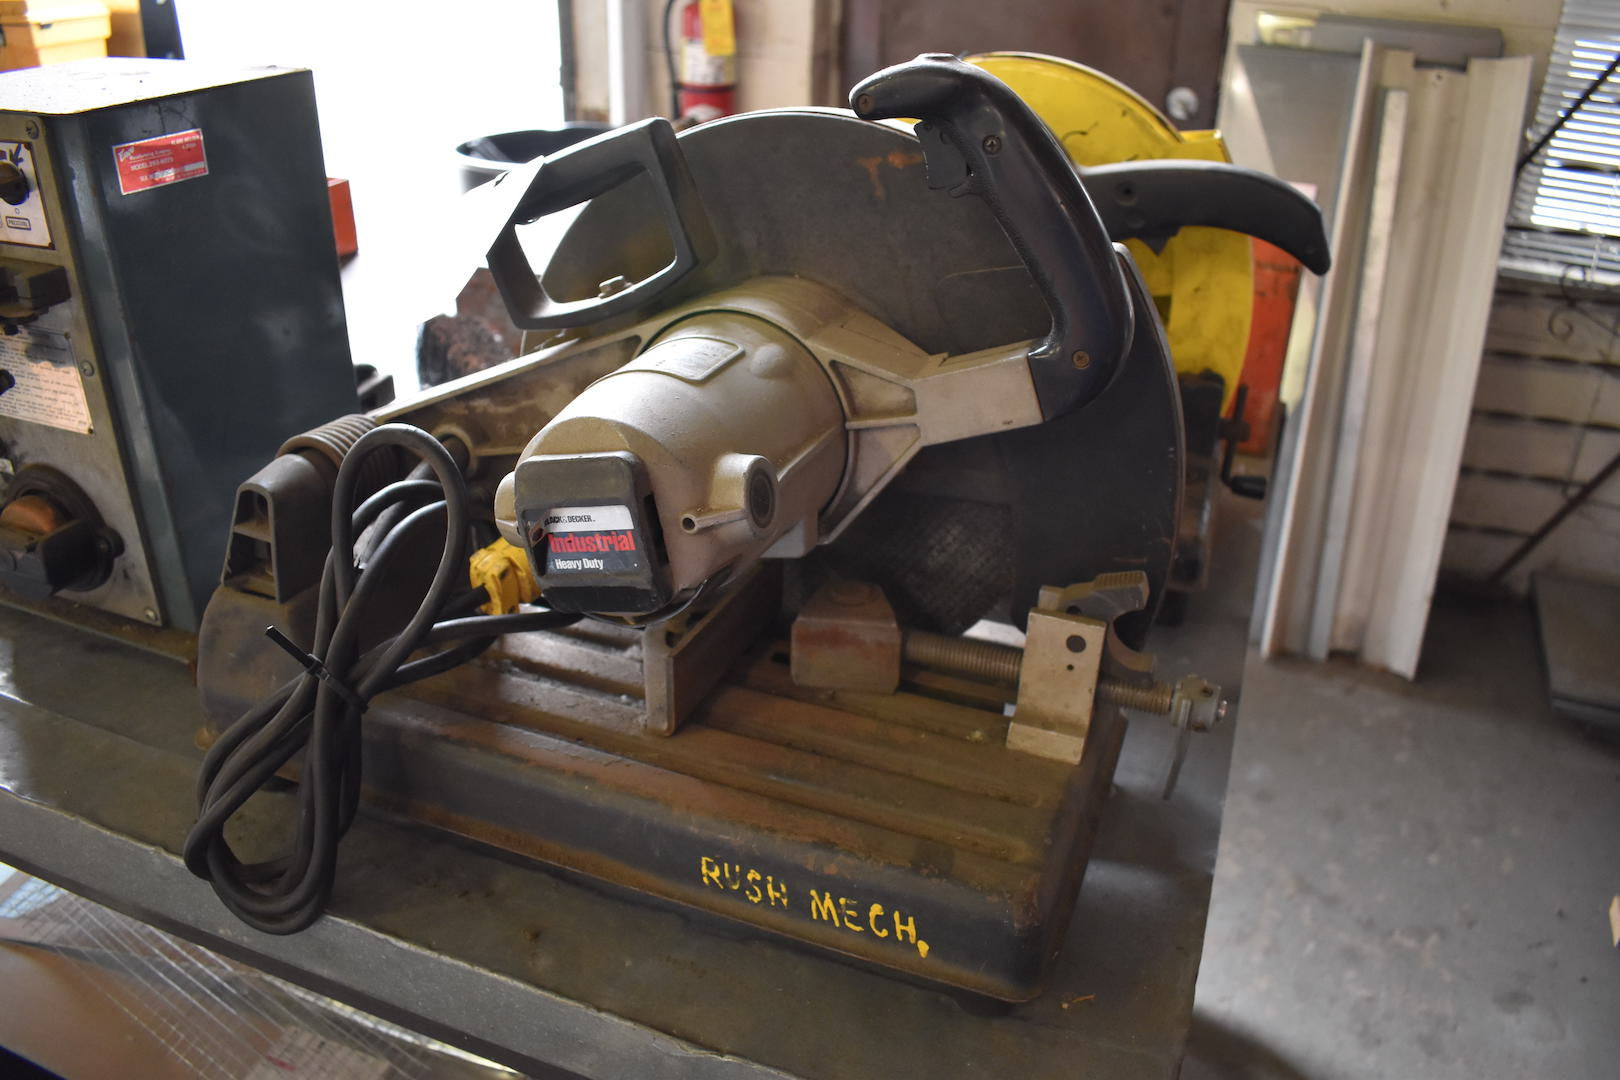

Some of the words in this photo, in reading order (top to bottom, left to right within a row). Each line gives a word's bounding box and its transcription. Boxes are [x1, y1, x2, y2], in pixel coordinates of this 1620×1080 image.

[567, 514, 593, 523] DECKER
[547, 530, 636, 553] Industrial
[554, 558, 582, 570] Heavy
[582, 558, 604, 570] Duty
[701, 856, 788, 909] RUSH
